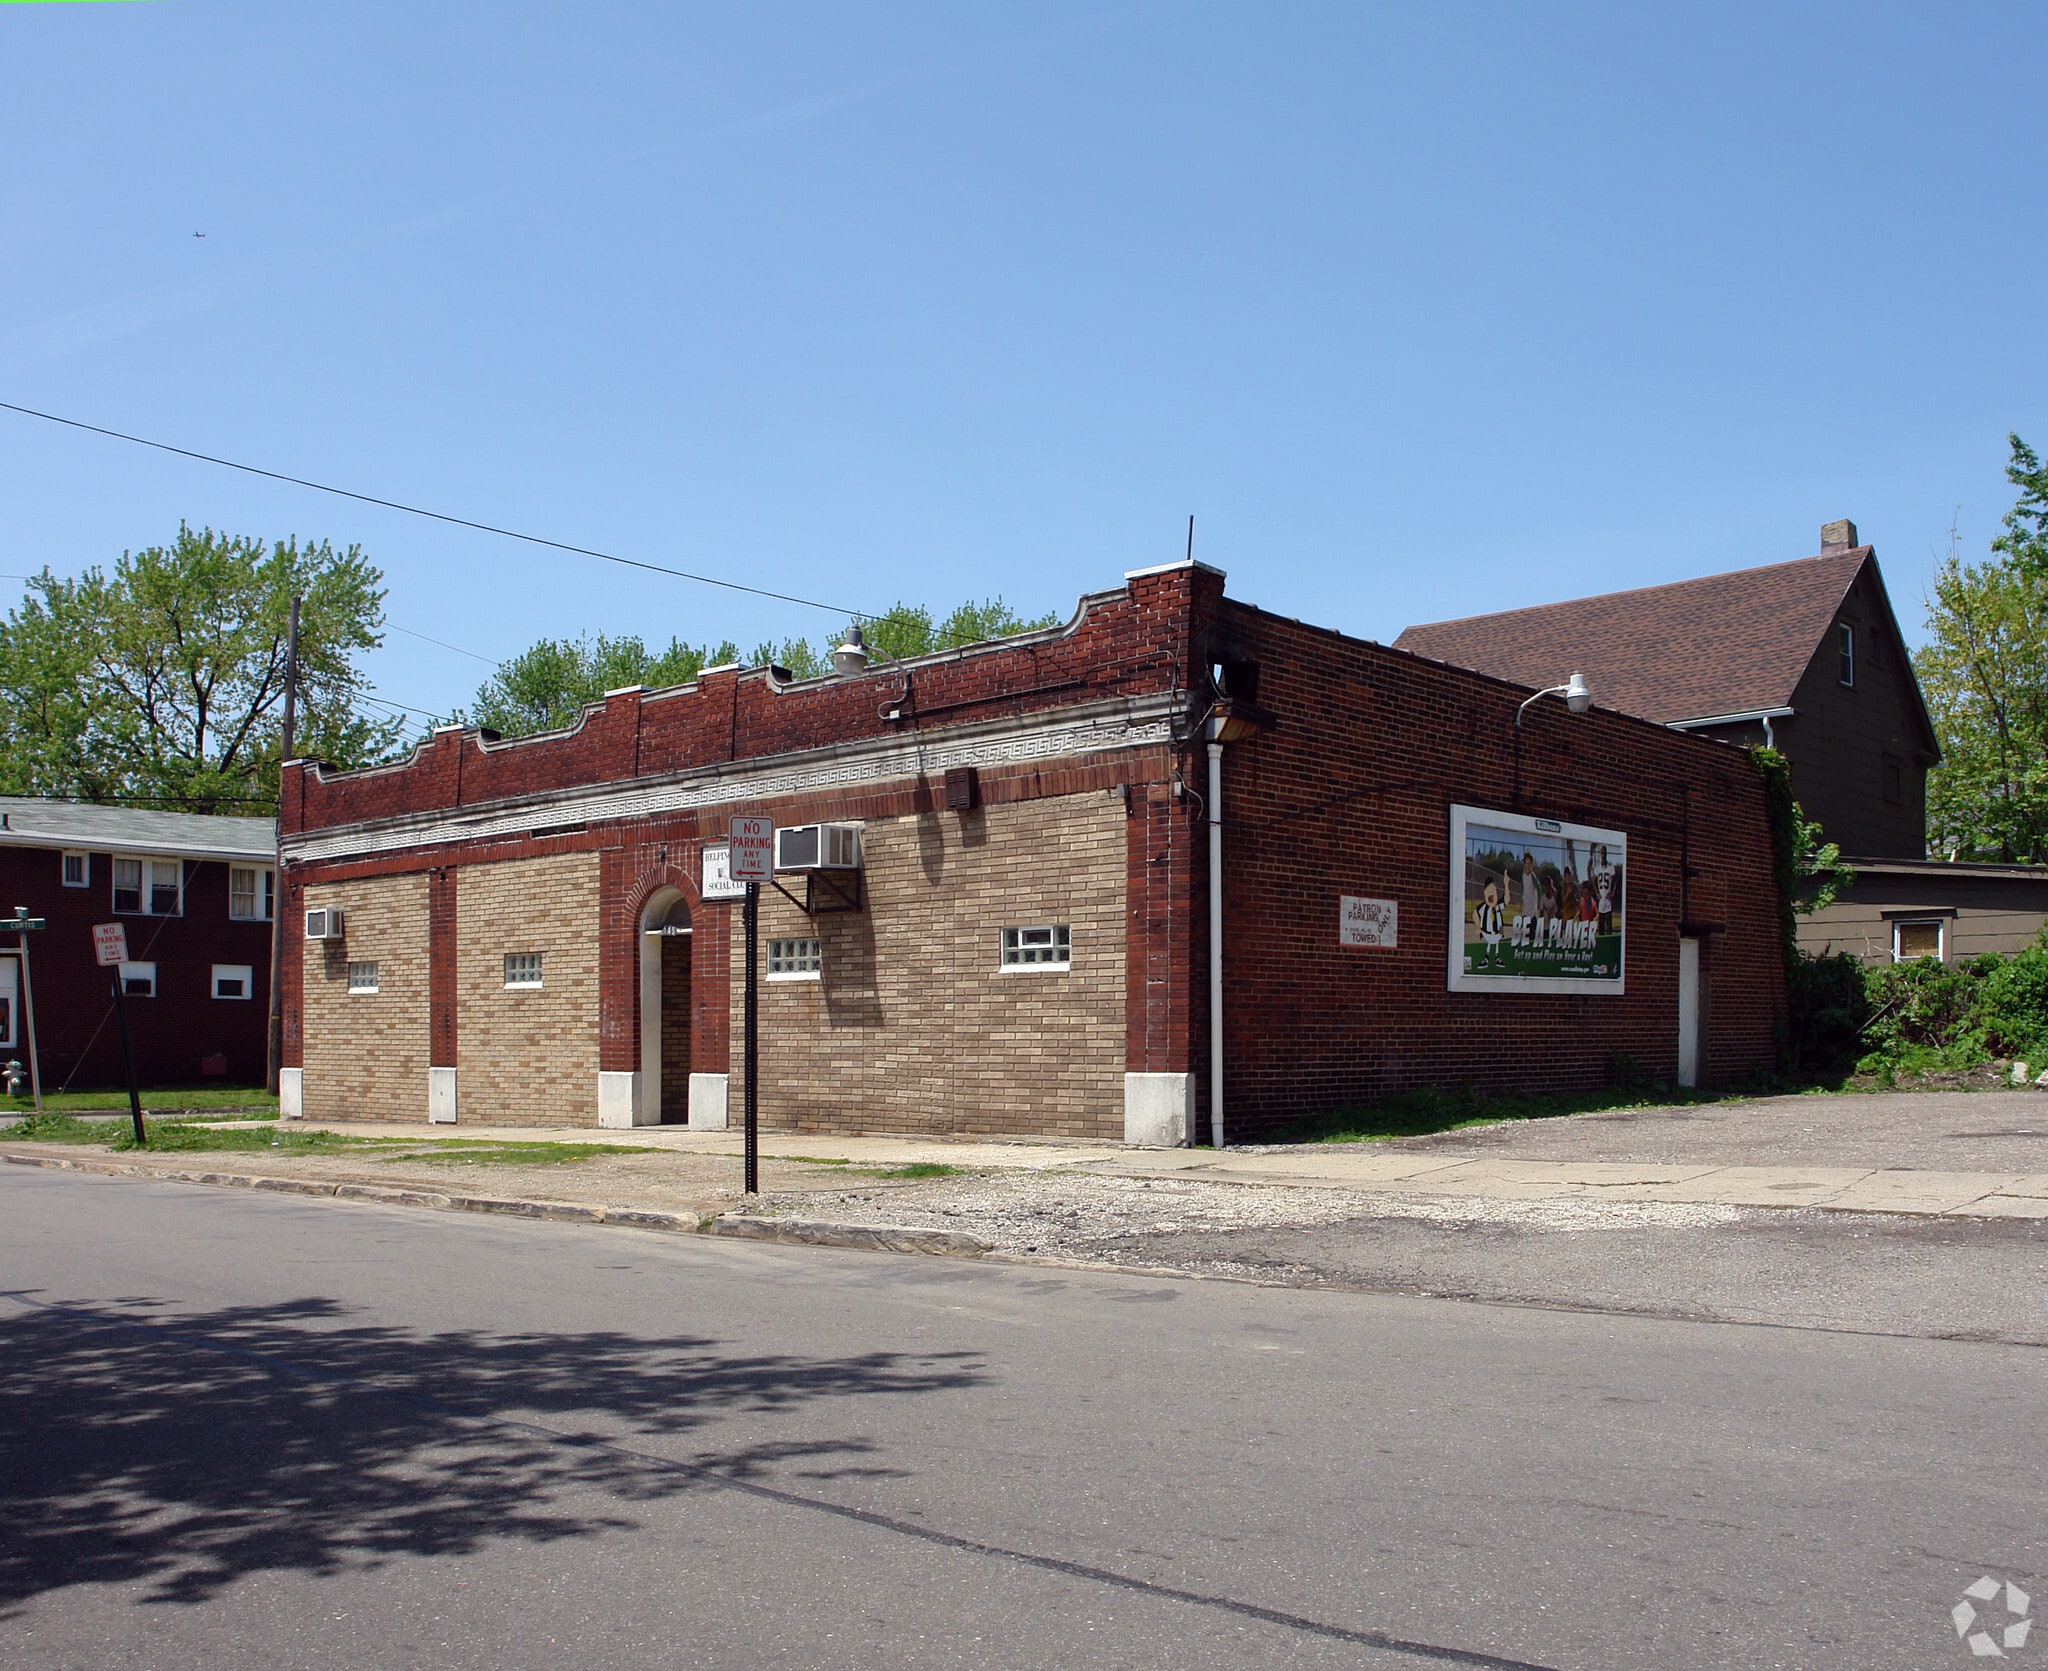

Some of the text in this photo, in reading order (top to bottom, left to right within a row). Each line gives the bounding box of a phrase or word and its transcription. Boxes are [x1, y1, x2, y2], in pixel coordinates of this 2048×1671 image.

[743, 822, 760, 834] NO
[733, 836, 771, 849] PARKING
[705, 850, 730, 861] HELPIN
[743, 850, 760, 858] ANY
[741, 859, 763, 868] TIME
[1598, 872, 1610, 890] 25
[1352, 902, 1382, 914] PATRON
[1348, 911, 1378, 922] PARKING
[10, 921, 35, 929] CURTIS
[102, 927, 115, 935] NO
[1510, 915, 1598, 949] BE A PLAYER
